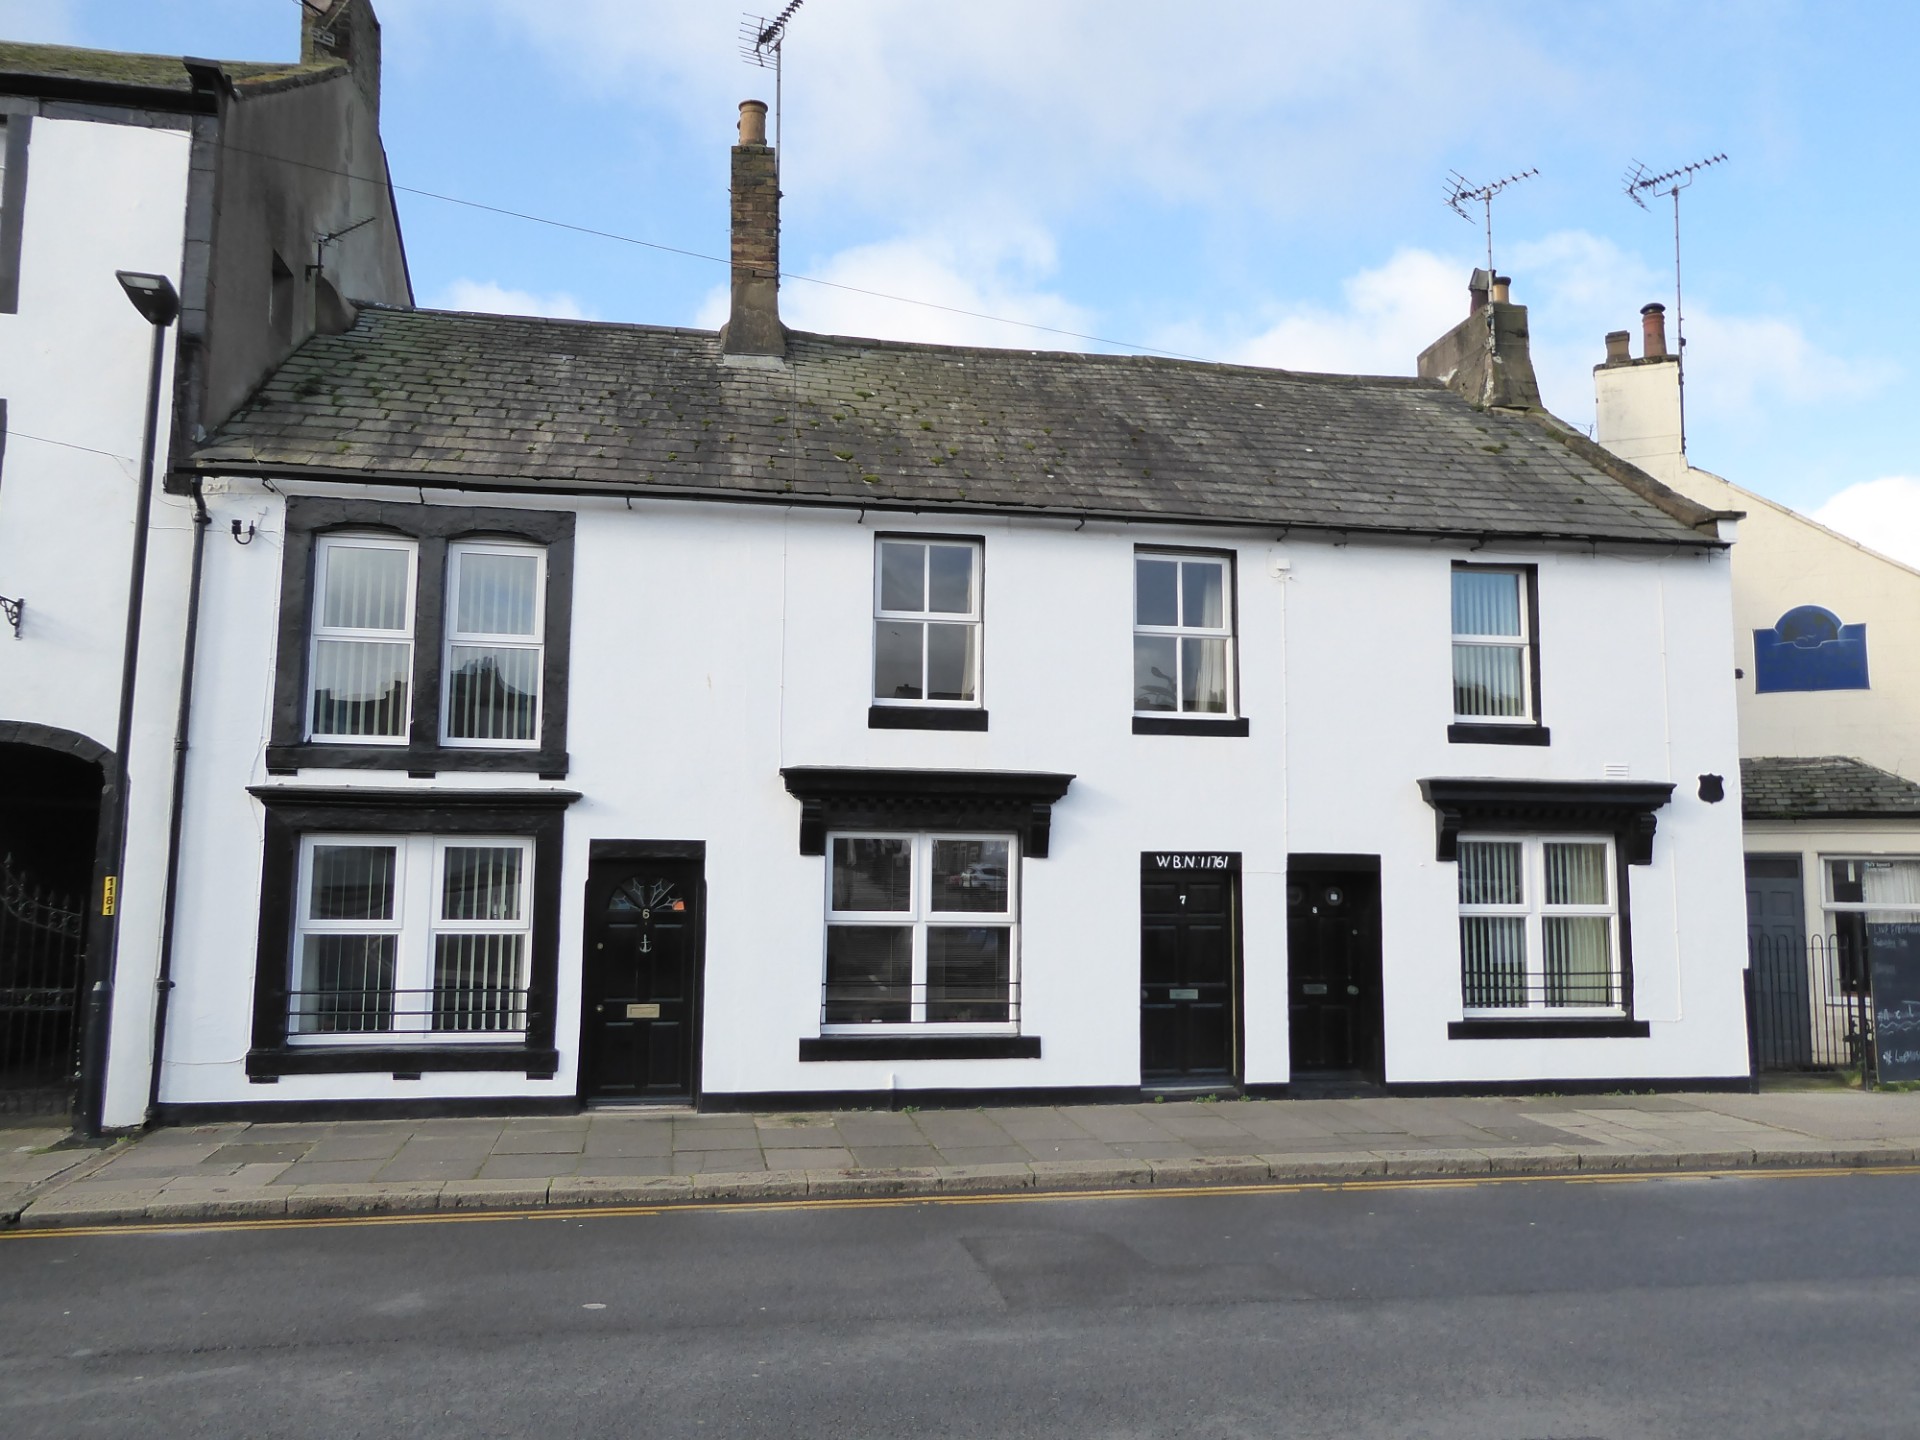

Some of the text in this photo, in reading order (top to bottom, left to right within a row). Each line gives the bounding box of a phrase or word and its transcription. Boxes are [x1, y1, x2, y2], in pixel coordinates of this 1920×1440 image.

[105, 877, 114, 915] 1181
[1179, 895, 1186, 905] 7
[642, 908, 650, 919] 6
